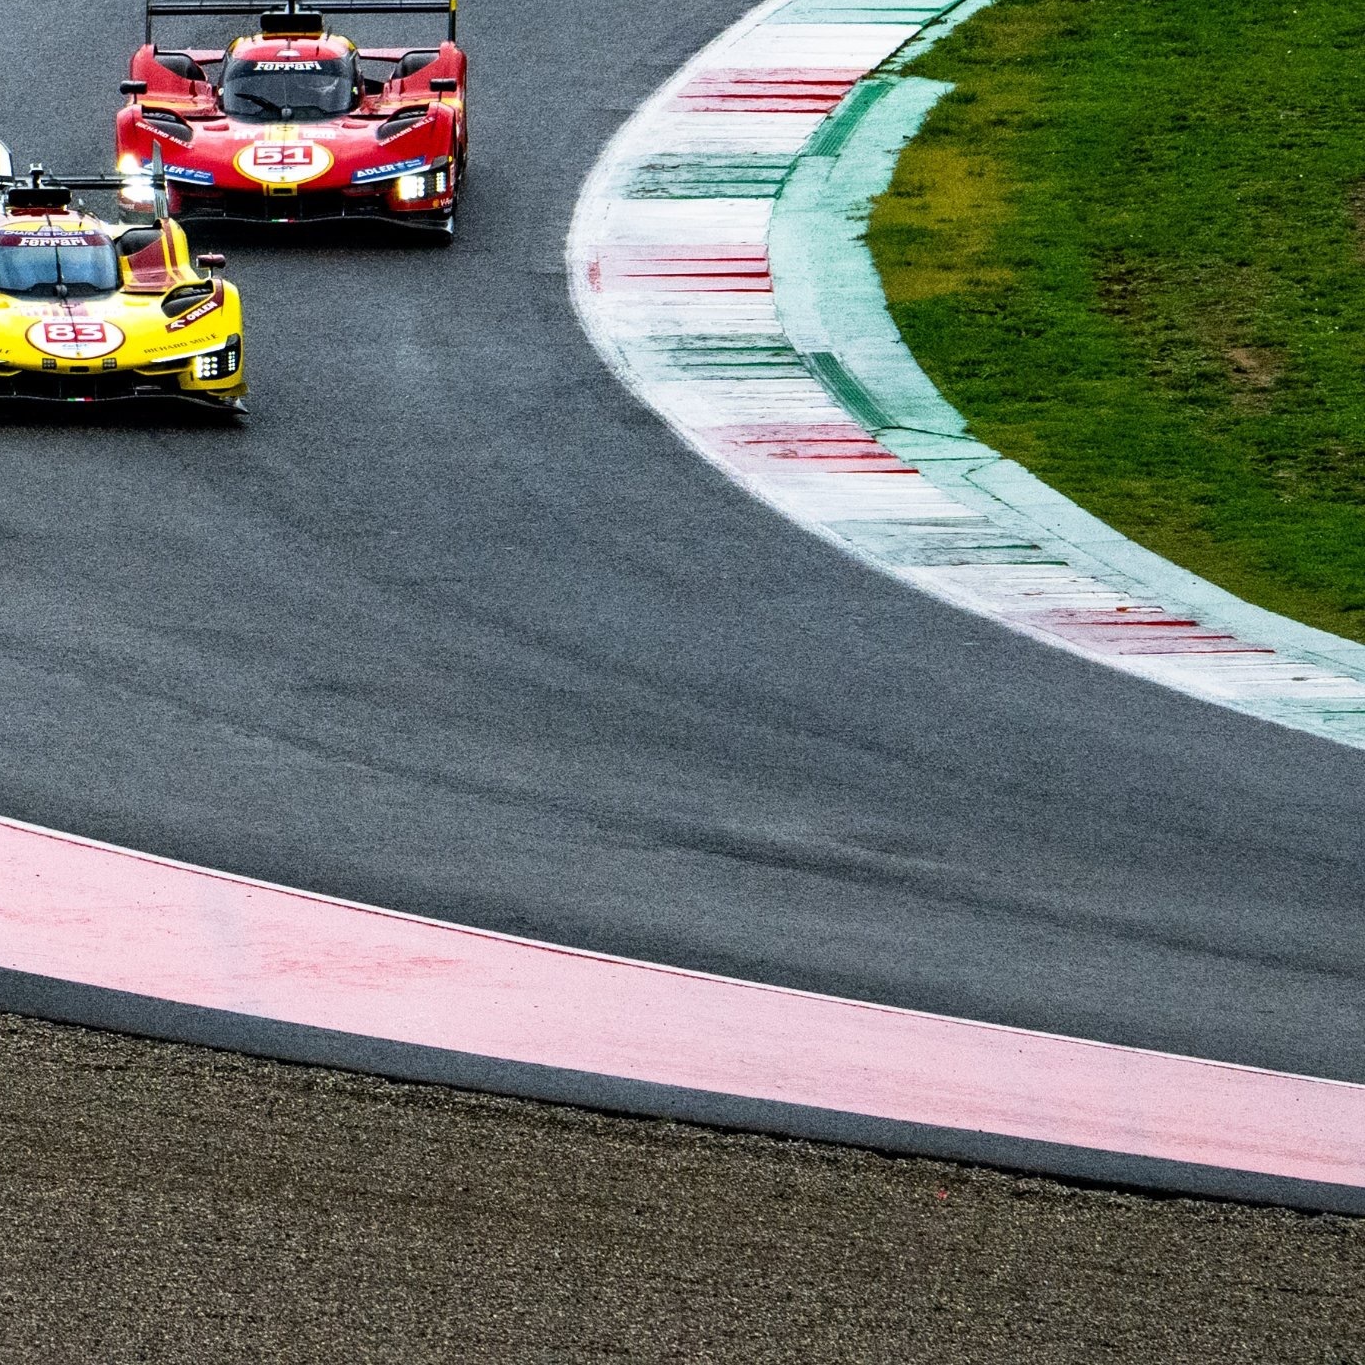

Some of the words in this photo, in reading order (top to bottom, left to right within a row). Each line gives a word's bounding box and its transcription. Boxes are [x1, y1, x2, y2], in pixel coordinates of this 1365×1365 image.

[253, 61, 322, 71] Ferrari
[256, 147, 310, 164] 51
[357, 164, 396, 178] ADLER
[18, 236, 88, 247] Ferrari
[186, 300, 218, 321] ORLEN
[47, 324, 104, 341] 83
[144, 341, 188, 354] RICHARD
